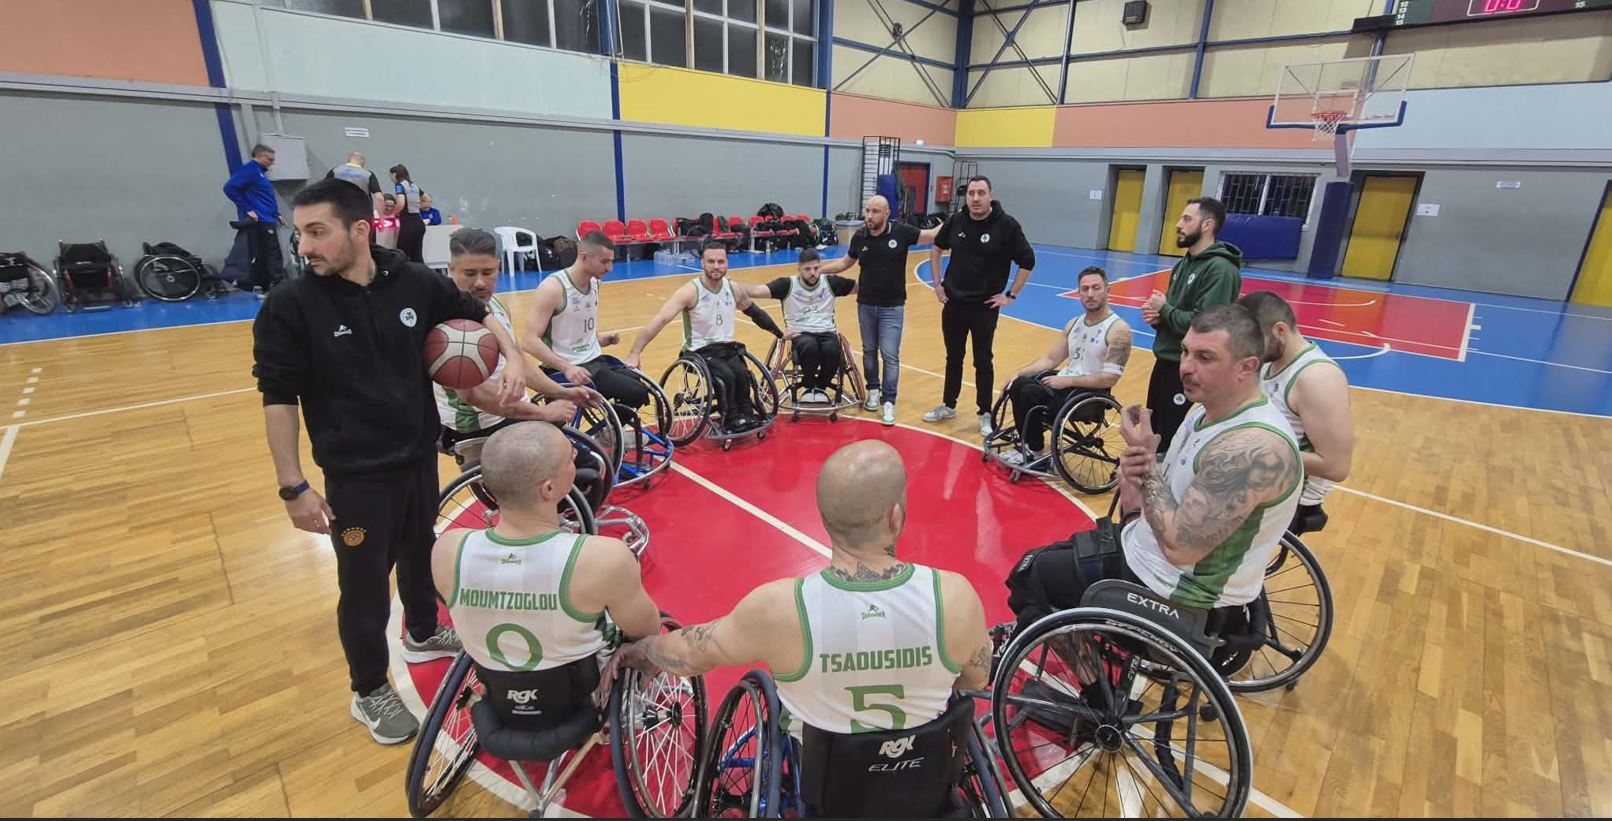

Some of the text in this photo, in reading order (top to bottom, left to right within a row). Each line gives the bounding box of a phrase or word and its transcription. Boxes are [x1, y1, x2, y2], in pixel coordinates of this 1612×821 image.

[584, 317, 594, 333] 10
[716, 313, 724, 326] 8
[460, 588, 558, 611] MOUMTZOGLOU
[1126, 592, 1179, 619] EXTRA
[485, 622, 544, 672] 0
[819, 645, 933, 673] TSAOUSIDIS
[844, 684, 907, 736] 5
[868, 757, 925, 772] ELITE
